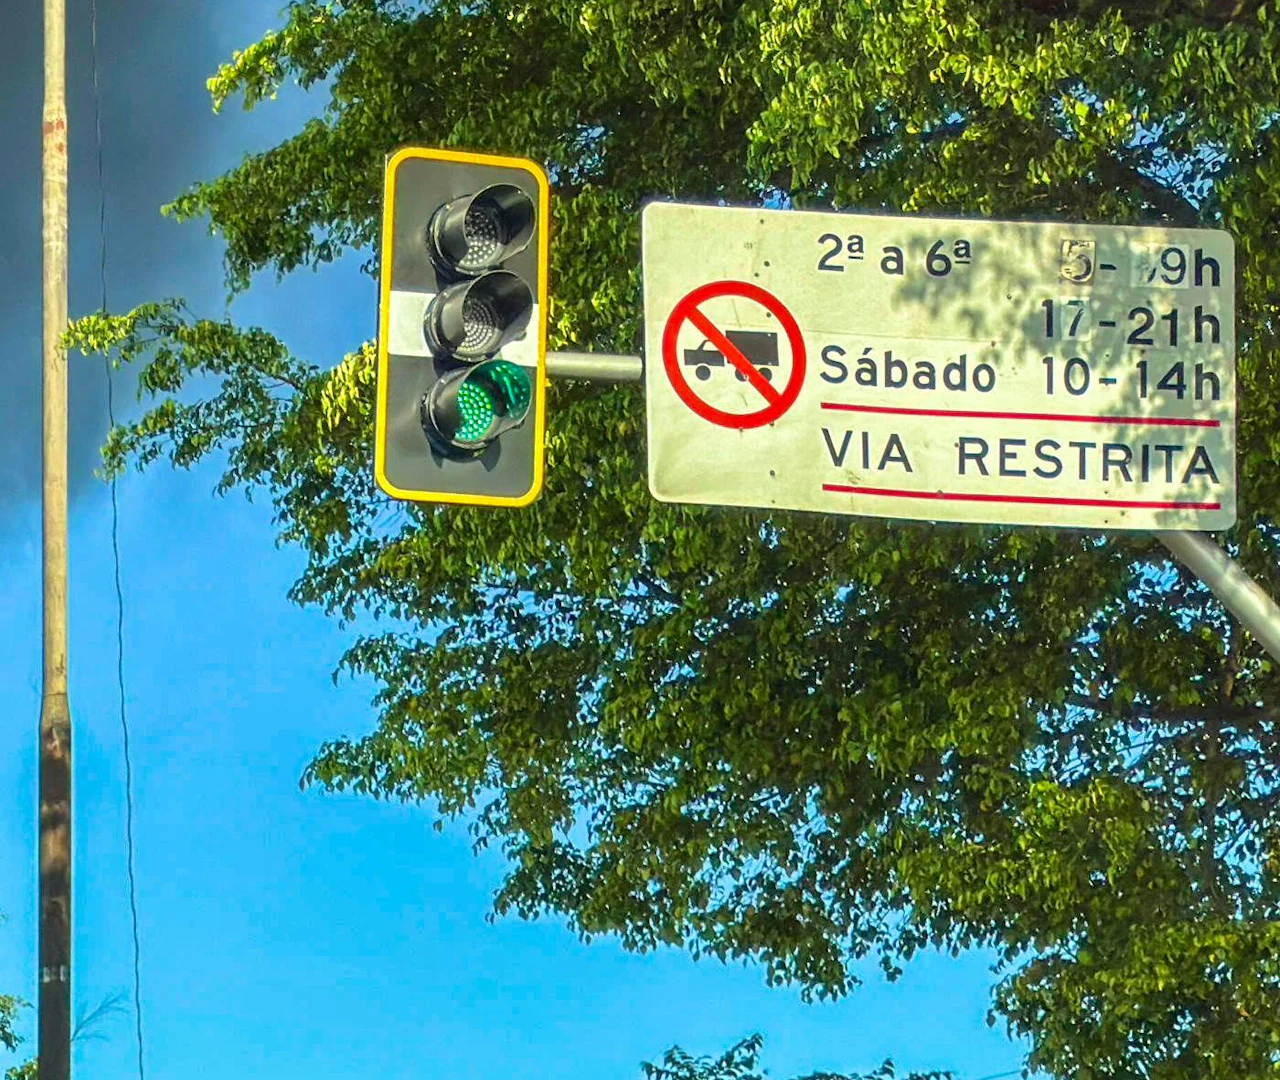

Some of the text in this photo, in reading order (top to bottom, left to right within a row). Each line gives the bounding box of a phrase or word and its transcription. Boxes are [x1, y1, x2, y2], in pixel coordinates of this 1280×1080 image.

[818, 233, 864, 273] 2ª
[880, 245, 905, 276] a
[925, 238, 972, 277] 6ª
[1042, 299, 1221, 346] 17-21h
[820, 343, 1221, 401] Sábado 10-14h
[821, 427, 1221, 485] VIA RESTRITA
